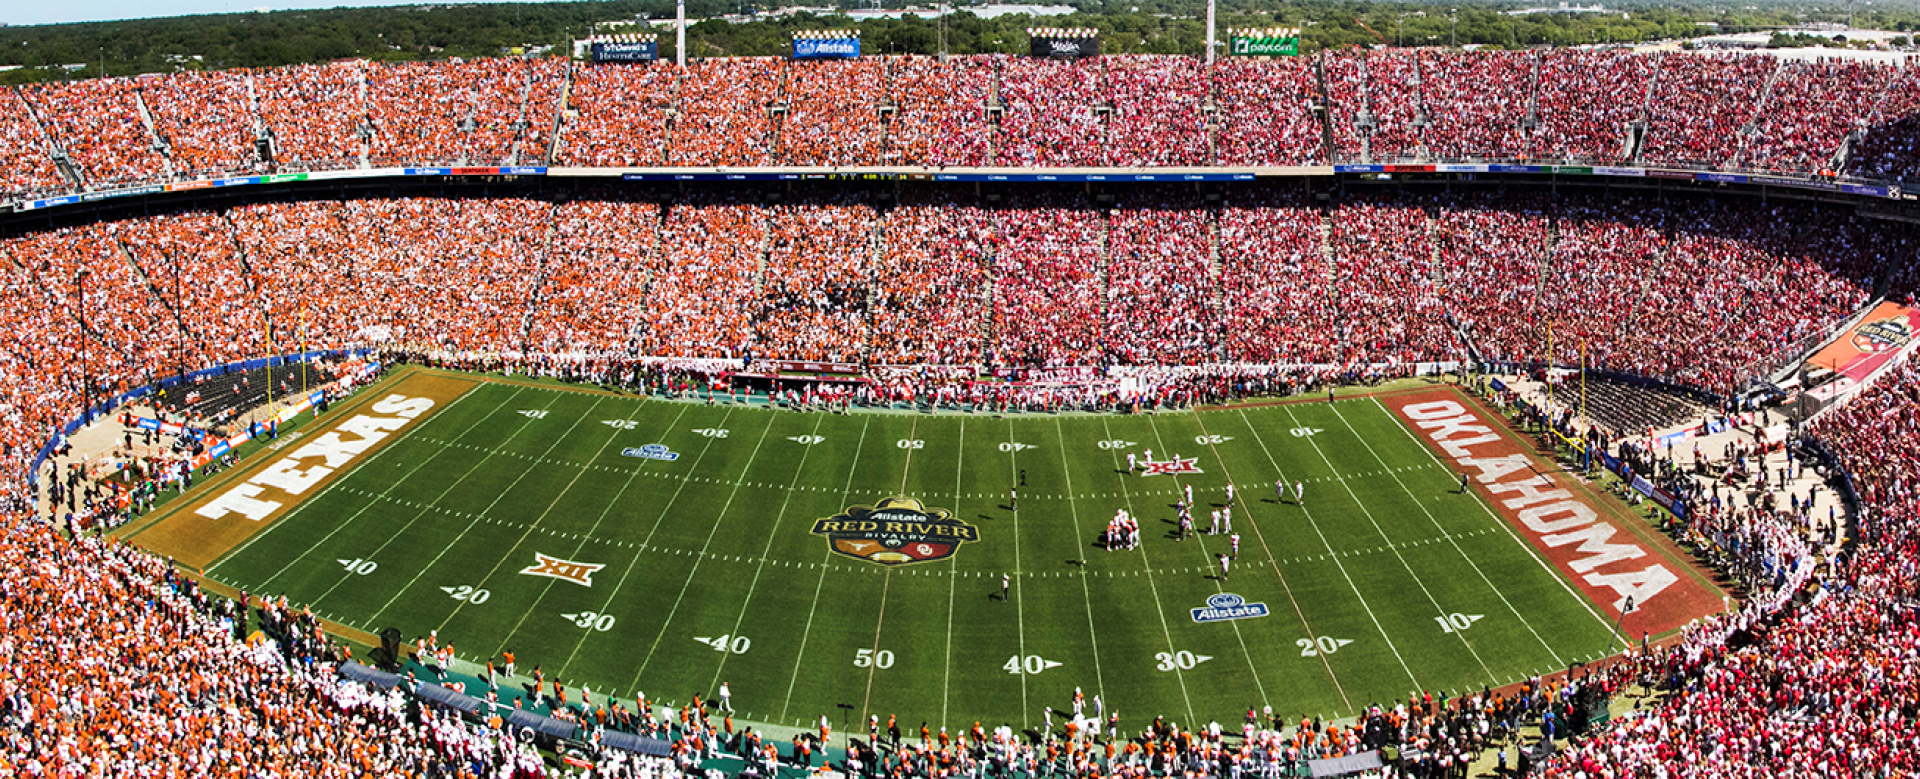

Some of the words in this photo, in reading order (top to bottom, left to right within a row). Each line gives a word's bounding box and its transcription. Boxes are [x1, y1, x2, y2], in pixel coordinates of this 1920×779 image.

[815, 43, 855, 54] Allstate
[1251, 43, 1293, 53] paycom
[194, 394, 435, 521] TEXAS
[870, 512, 927, 522] Allstate
[1401, 399, 1680, 615] OKLAHOMA
[821, 521, 878, 533] RED
[885, 521, 972, 539] RIVER
[865, 532, 927, 541] RIVALRY
[347, 558, 378, 576] 10
[451, 584, 491, 605] 20
[576, 611, 616, 632] 30
[1197, 606, 1262, 620] Allstate
[1434, 612, 1472, 633] 10
[710, 634, 751, 655] 40
[1295, 635, 1338, 657] 20
[853, 648, 895, 669] 50
[1003, 654, 1044, 675] 40
[1154, 650, 1197, 672] 30
